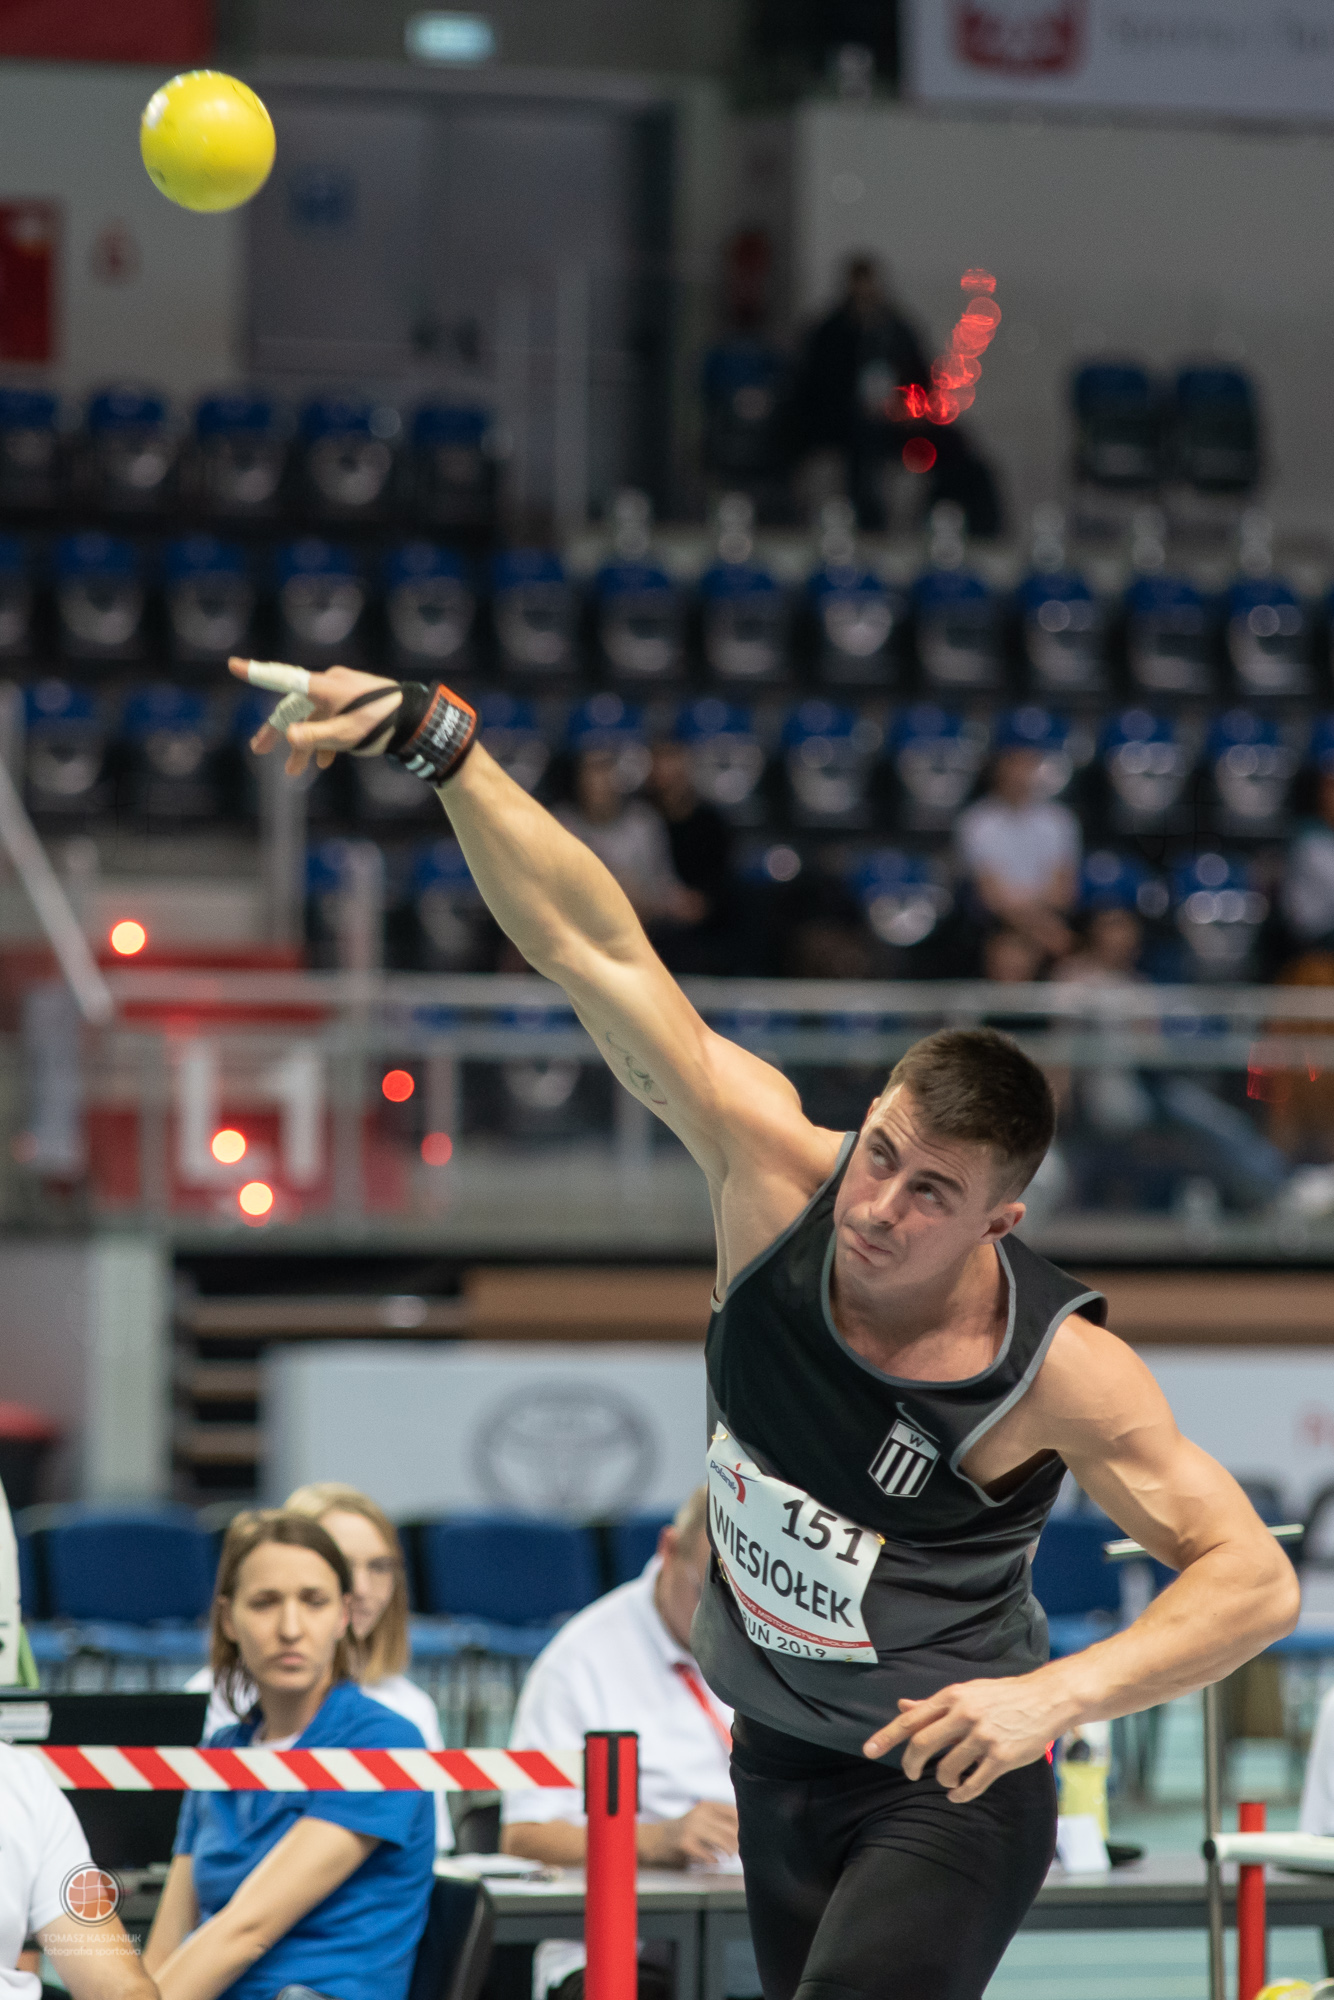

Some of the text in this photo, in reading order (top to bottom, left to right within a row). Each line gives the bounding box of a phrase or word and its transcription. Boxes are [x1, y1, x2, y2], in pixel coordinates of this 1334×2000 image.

[909, 1433, 925, 1448] W
[781, 1498, 864, 1566] 151
[713, 1494, 855, 1628] WIESIOŁEK
[777, 1636, 826, 1658] 2019
